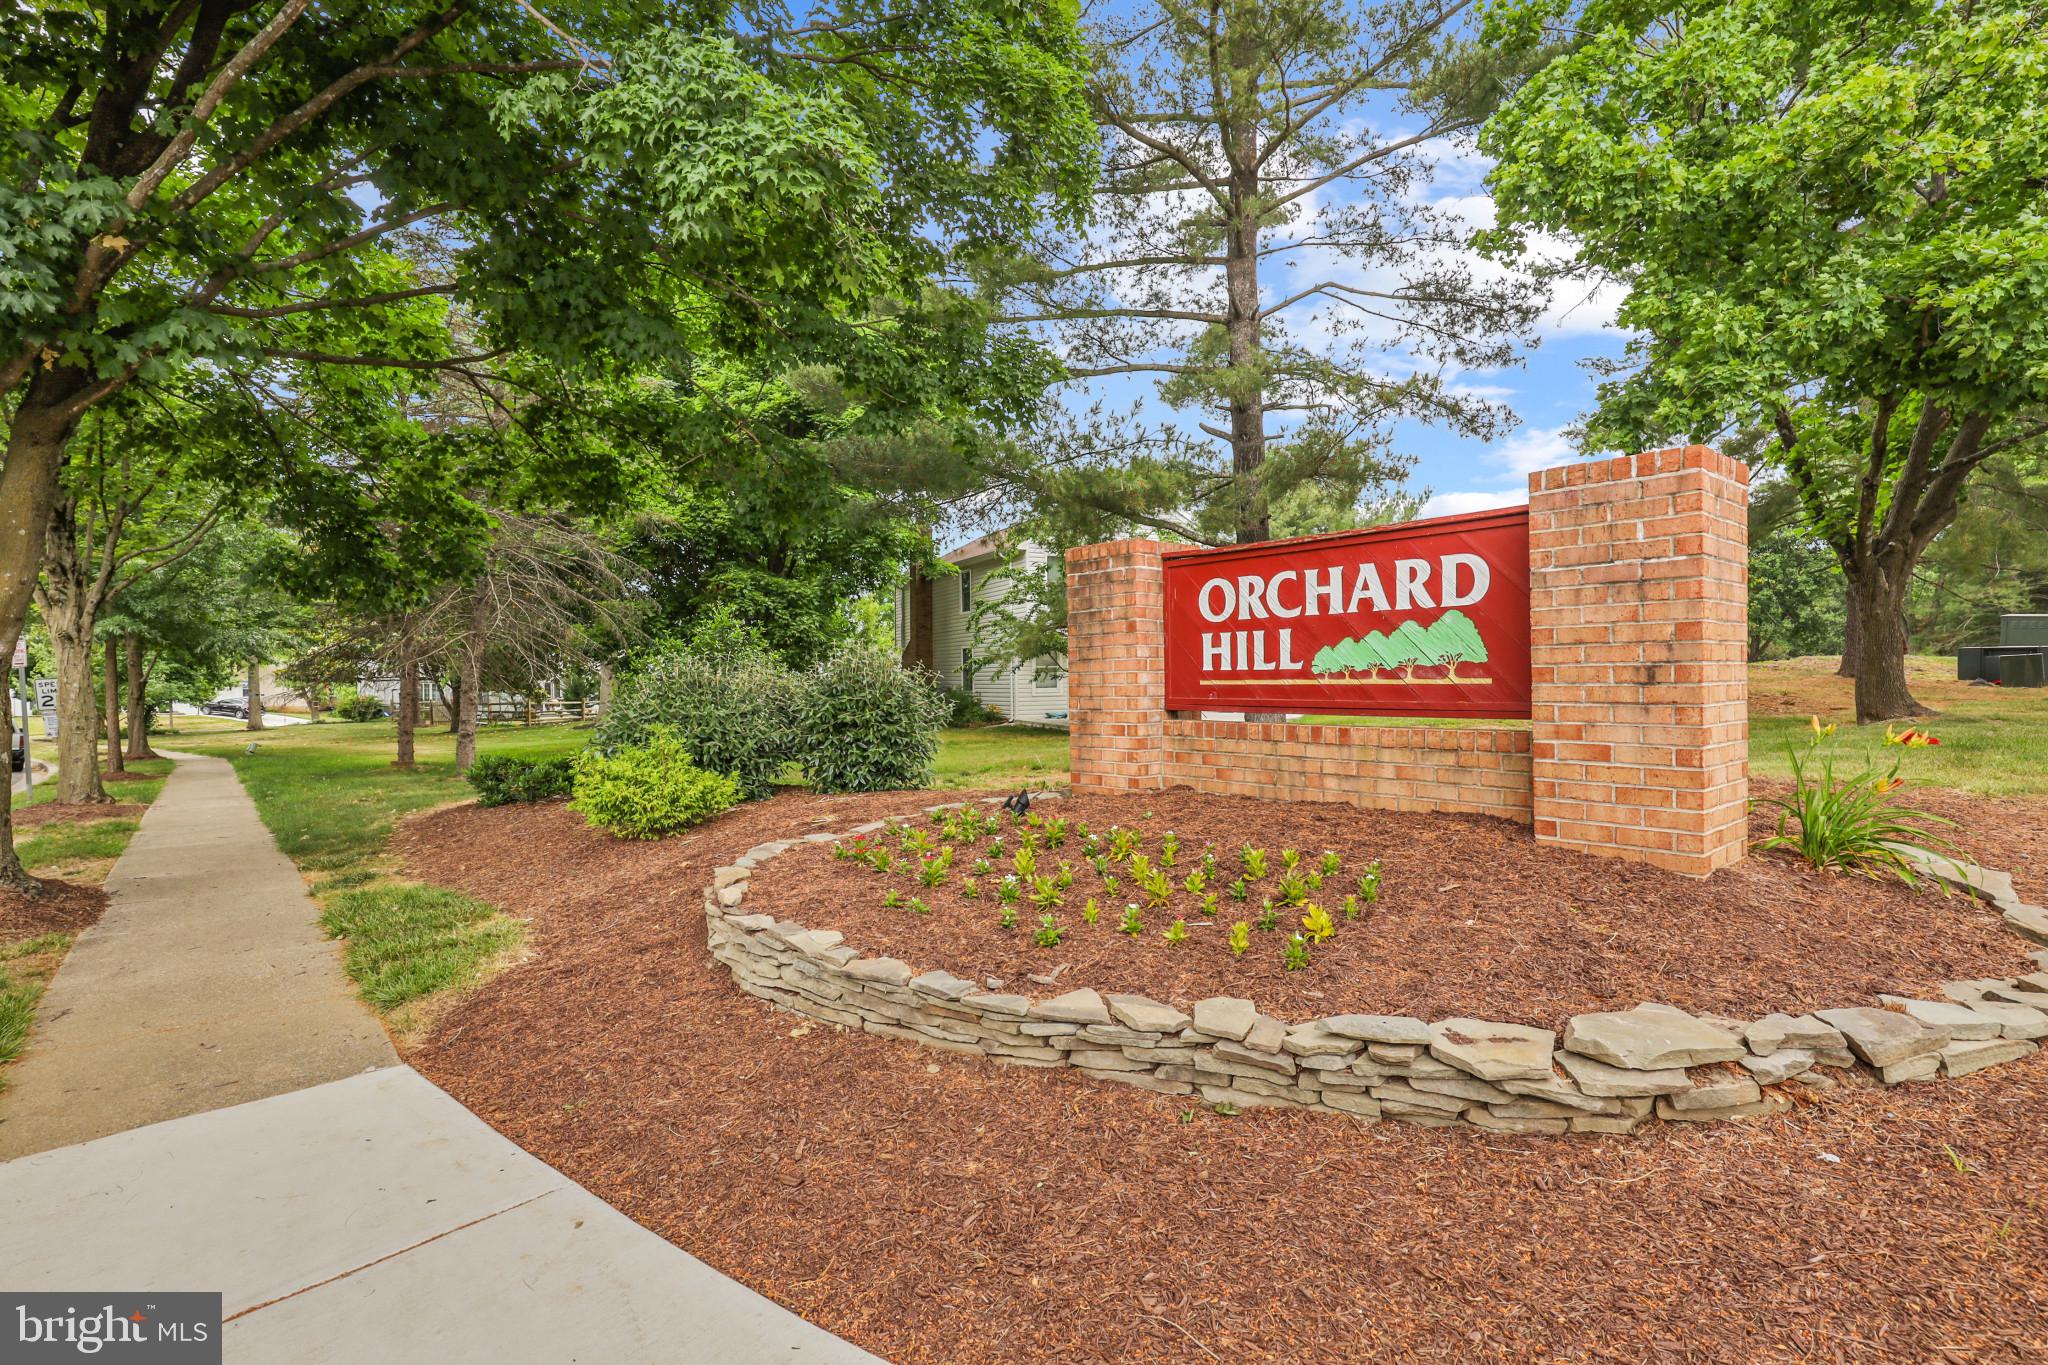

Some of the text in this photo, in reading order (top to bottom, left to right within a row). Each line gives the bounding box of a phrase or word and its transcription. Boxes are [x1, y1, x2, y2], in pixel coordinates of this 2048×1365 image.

[1198, 553, 1490, 623] ORCHARD
[1201, 628, 1304, 671] HILL
[41, 695, 55, 707] 2
